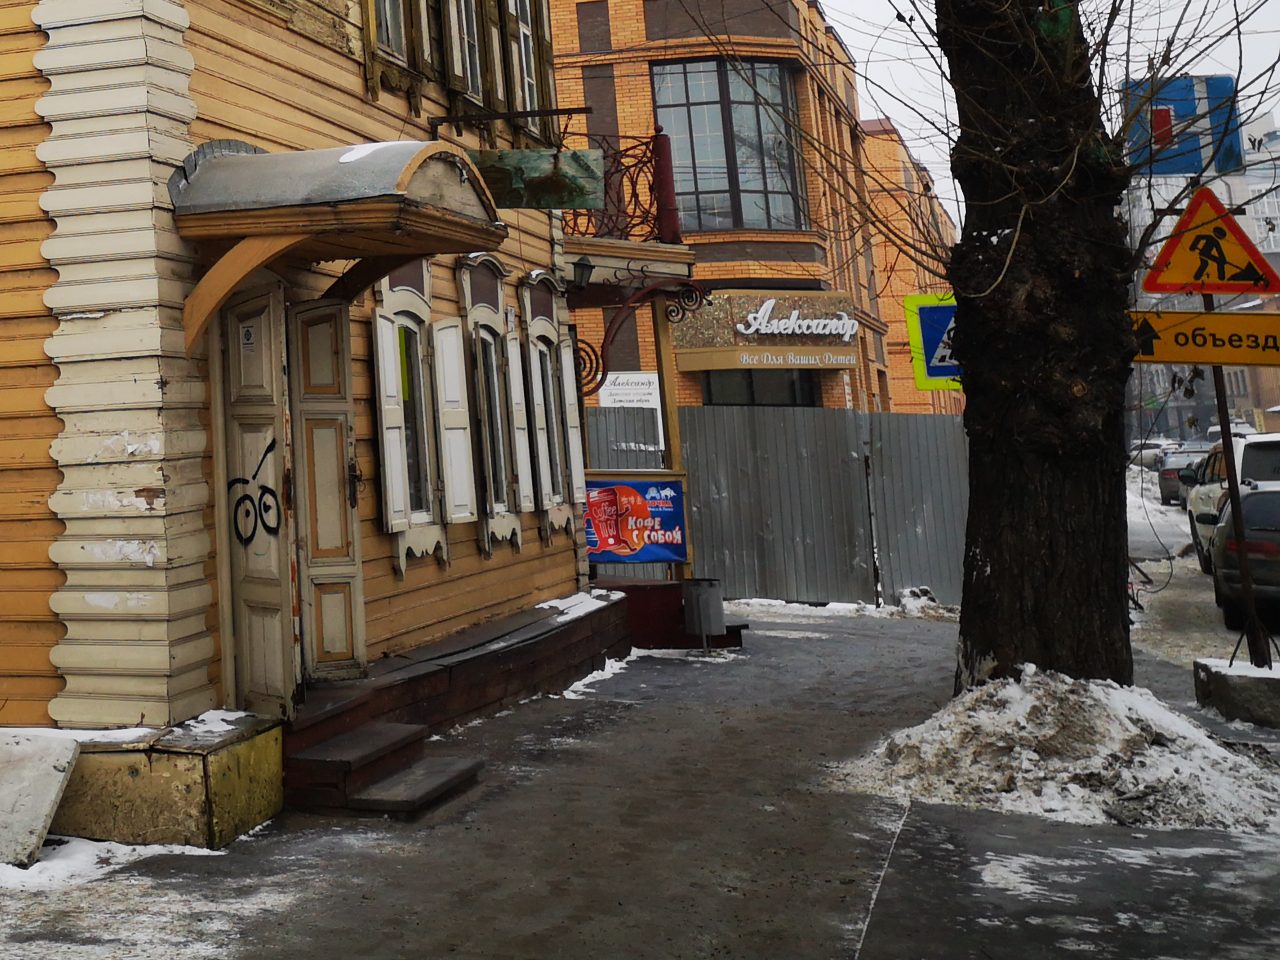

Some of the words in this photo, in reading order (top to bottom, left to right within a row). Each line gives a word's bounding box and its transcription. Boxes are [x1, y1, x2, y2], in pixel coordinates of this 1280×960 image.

[736, 298, 859, 341] Александр
[1174, 327, 1280, 352] объезд
[740, 353, 759, 364] Все
[761, 353, 783, 364] Для
[786, 353, 822, 366] Ваших
[823, 353, 857, 364] Детей
